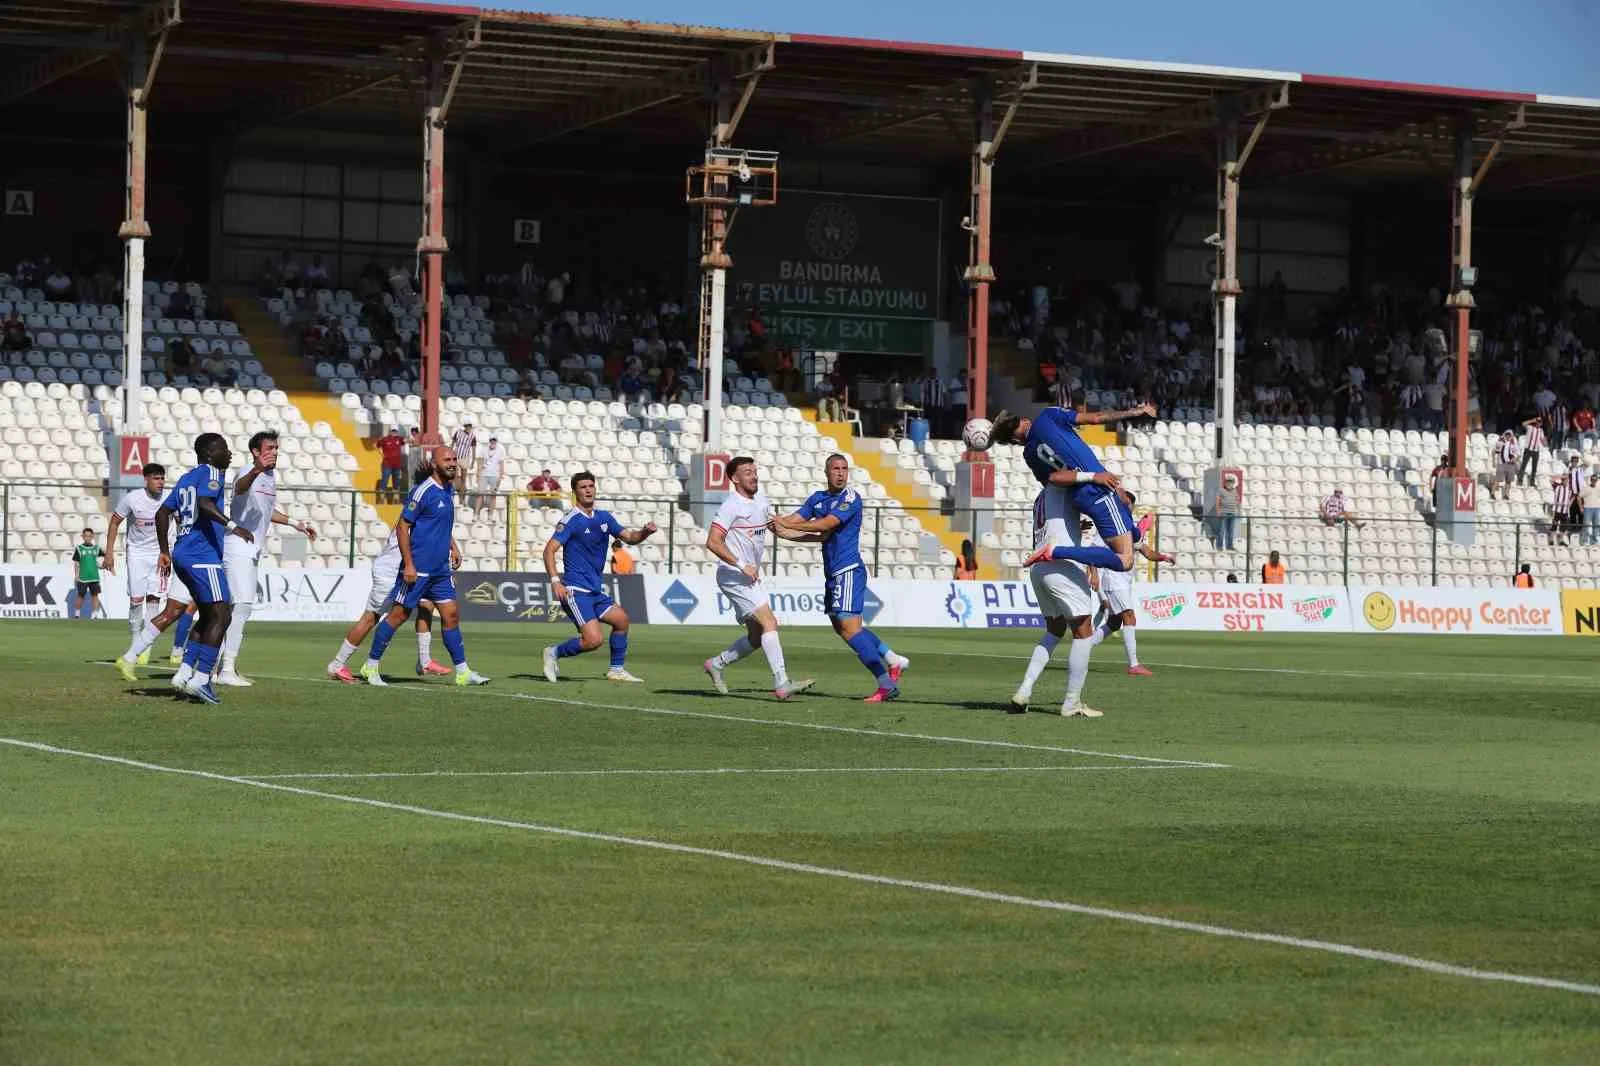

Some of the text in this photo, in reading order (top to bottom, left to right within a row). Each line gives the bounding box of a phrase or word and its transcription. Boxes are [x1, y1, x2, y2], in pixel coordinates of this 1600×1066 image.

[11, 193, 30, 213] A
[520, 222, 536, 241] B
[779, 260, 882, 285] BANDIRMA
[758, 281, 820, 304] EYLÜL
[824, 287, 928, 310] STADYUMU
[839, 321, 889, 340] EXIT
[125, 440, 144, 471] A
[708, 459, 725, 487] D
[1456, 482, 1474, 508] M
[1195, 588, 1284, 609] ZENGİN
[0, 607, 60, 618] umurta
[1223, 609, 1265, 631] SÜT
[1399, 600, 1552, 631] Happy Center
[1575, 607, 1600, 633] N
